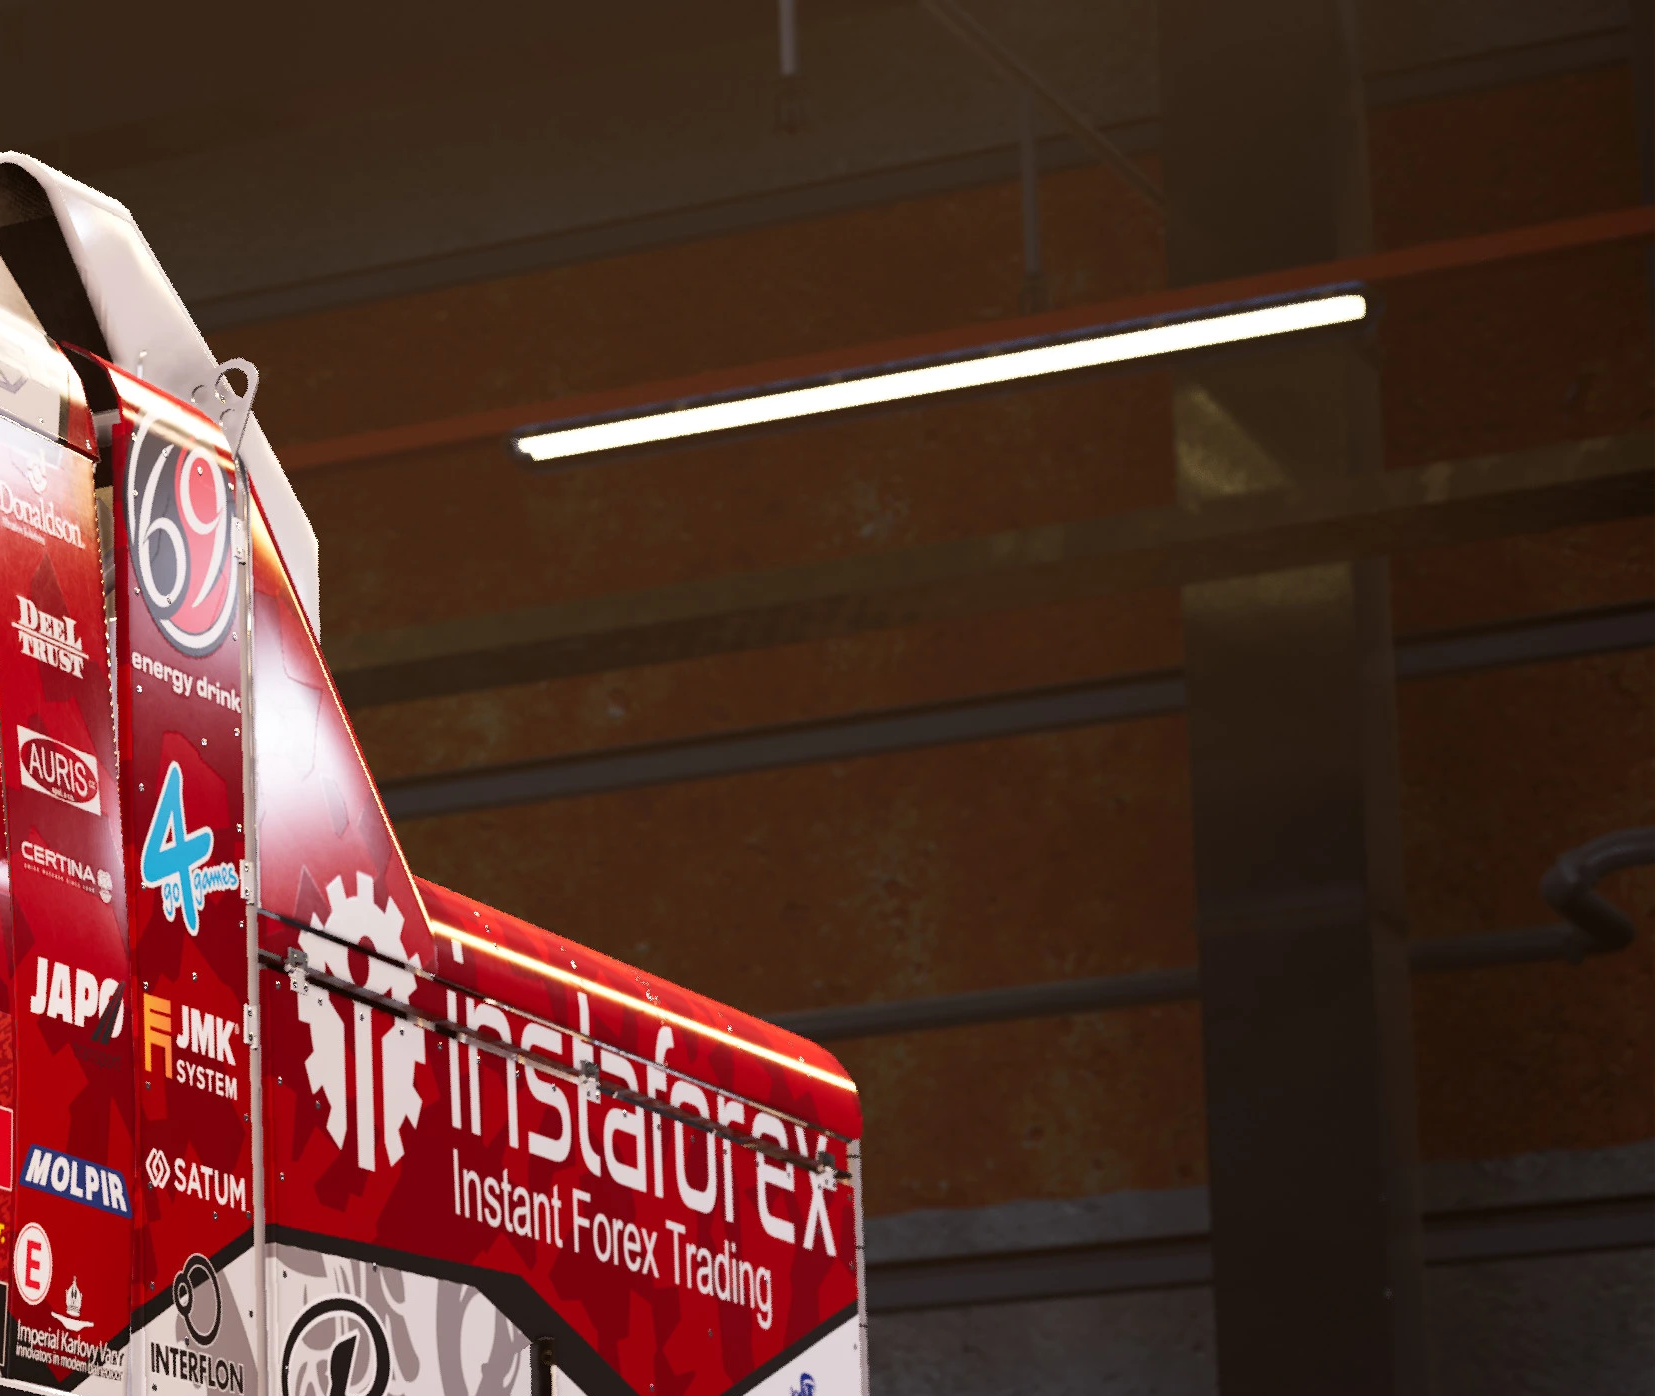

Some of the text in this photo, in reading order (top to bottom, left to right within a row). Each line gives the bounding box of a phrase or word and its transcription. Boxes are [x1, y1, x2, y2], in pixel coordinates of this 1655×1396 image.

[16, 595, 82, 650] DEEL
[19, 631, 83, 679] TRUST
[131, 651, 193, 697] energy
[29, 743, 88, 797] AURIS
[21, 840, 95, 884] CERTINA
[141, 761, 214, 936] 4
[192, 864, 239, 908] games
[176, 1059, 238, 1101] SYSTEM
[446, 938, 837, 1258] instaforex
[24, 1148, 128, 1213] MOLPIR
[174, 1158, 246, 1212] SATUM
[452, 1148, 773, 1331] Instant Forex Trading
[17, 1318, 60, 1351] Imperial
[61, 1330, 99, 1366] Karlovy
[150, 1342, 245, 1394] INTERFLON
